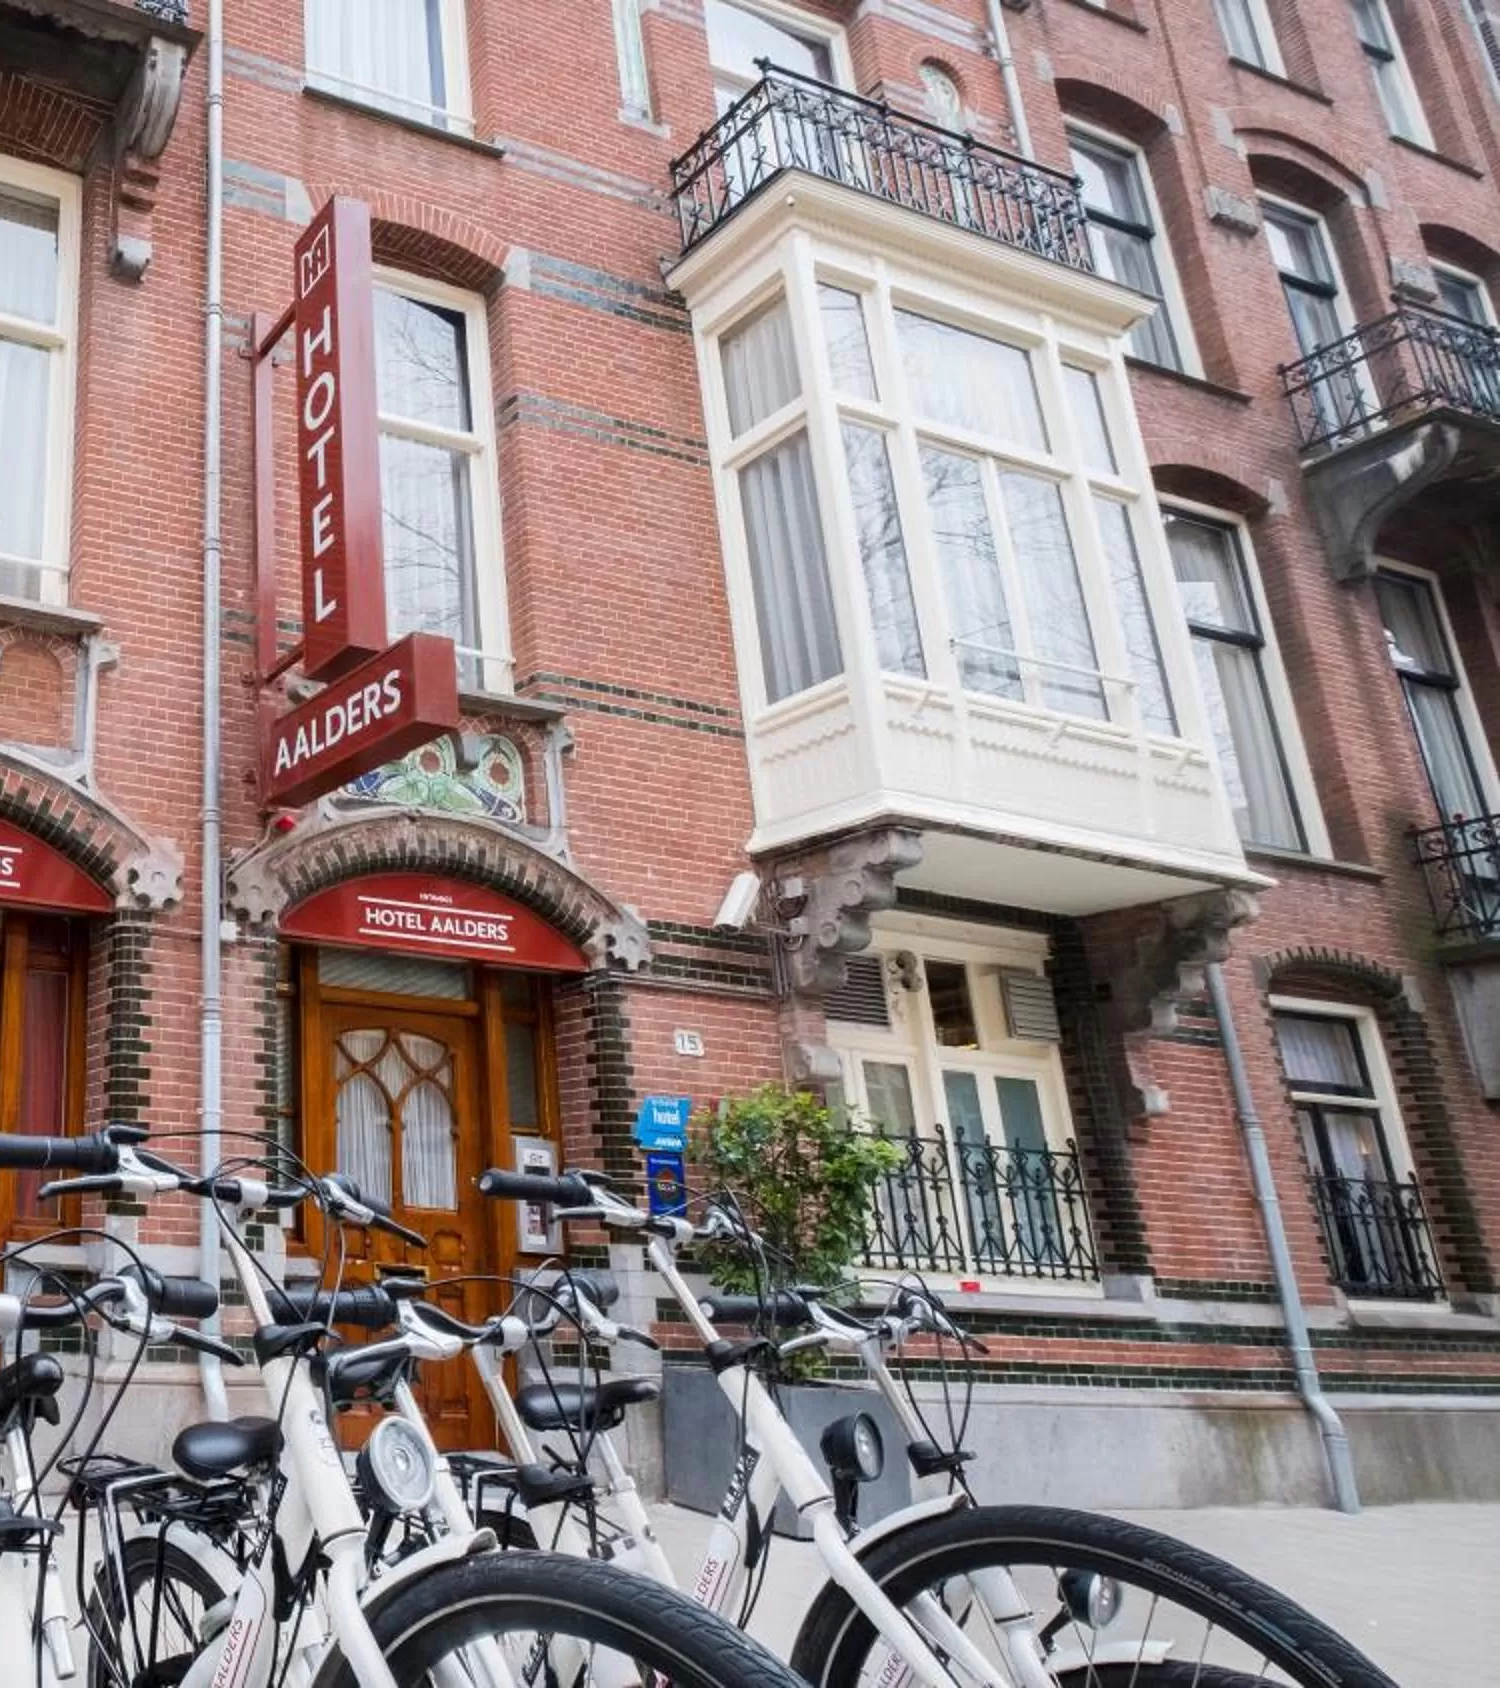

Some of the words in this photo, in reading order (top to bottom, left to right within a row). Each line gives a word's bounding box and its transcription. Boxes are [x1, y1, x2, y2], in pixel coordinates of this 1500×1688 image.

[303, 306, 337, 623] HOTEL
[274, 669, 402, 777] AALDERS
[365, 907, 427, 931] HOTEL
[431, 916, 508, 941] AALDERS
[679, 1034, 699, 1051] 15
[695, 1557, 719, 1603] LDERS
